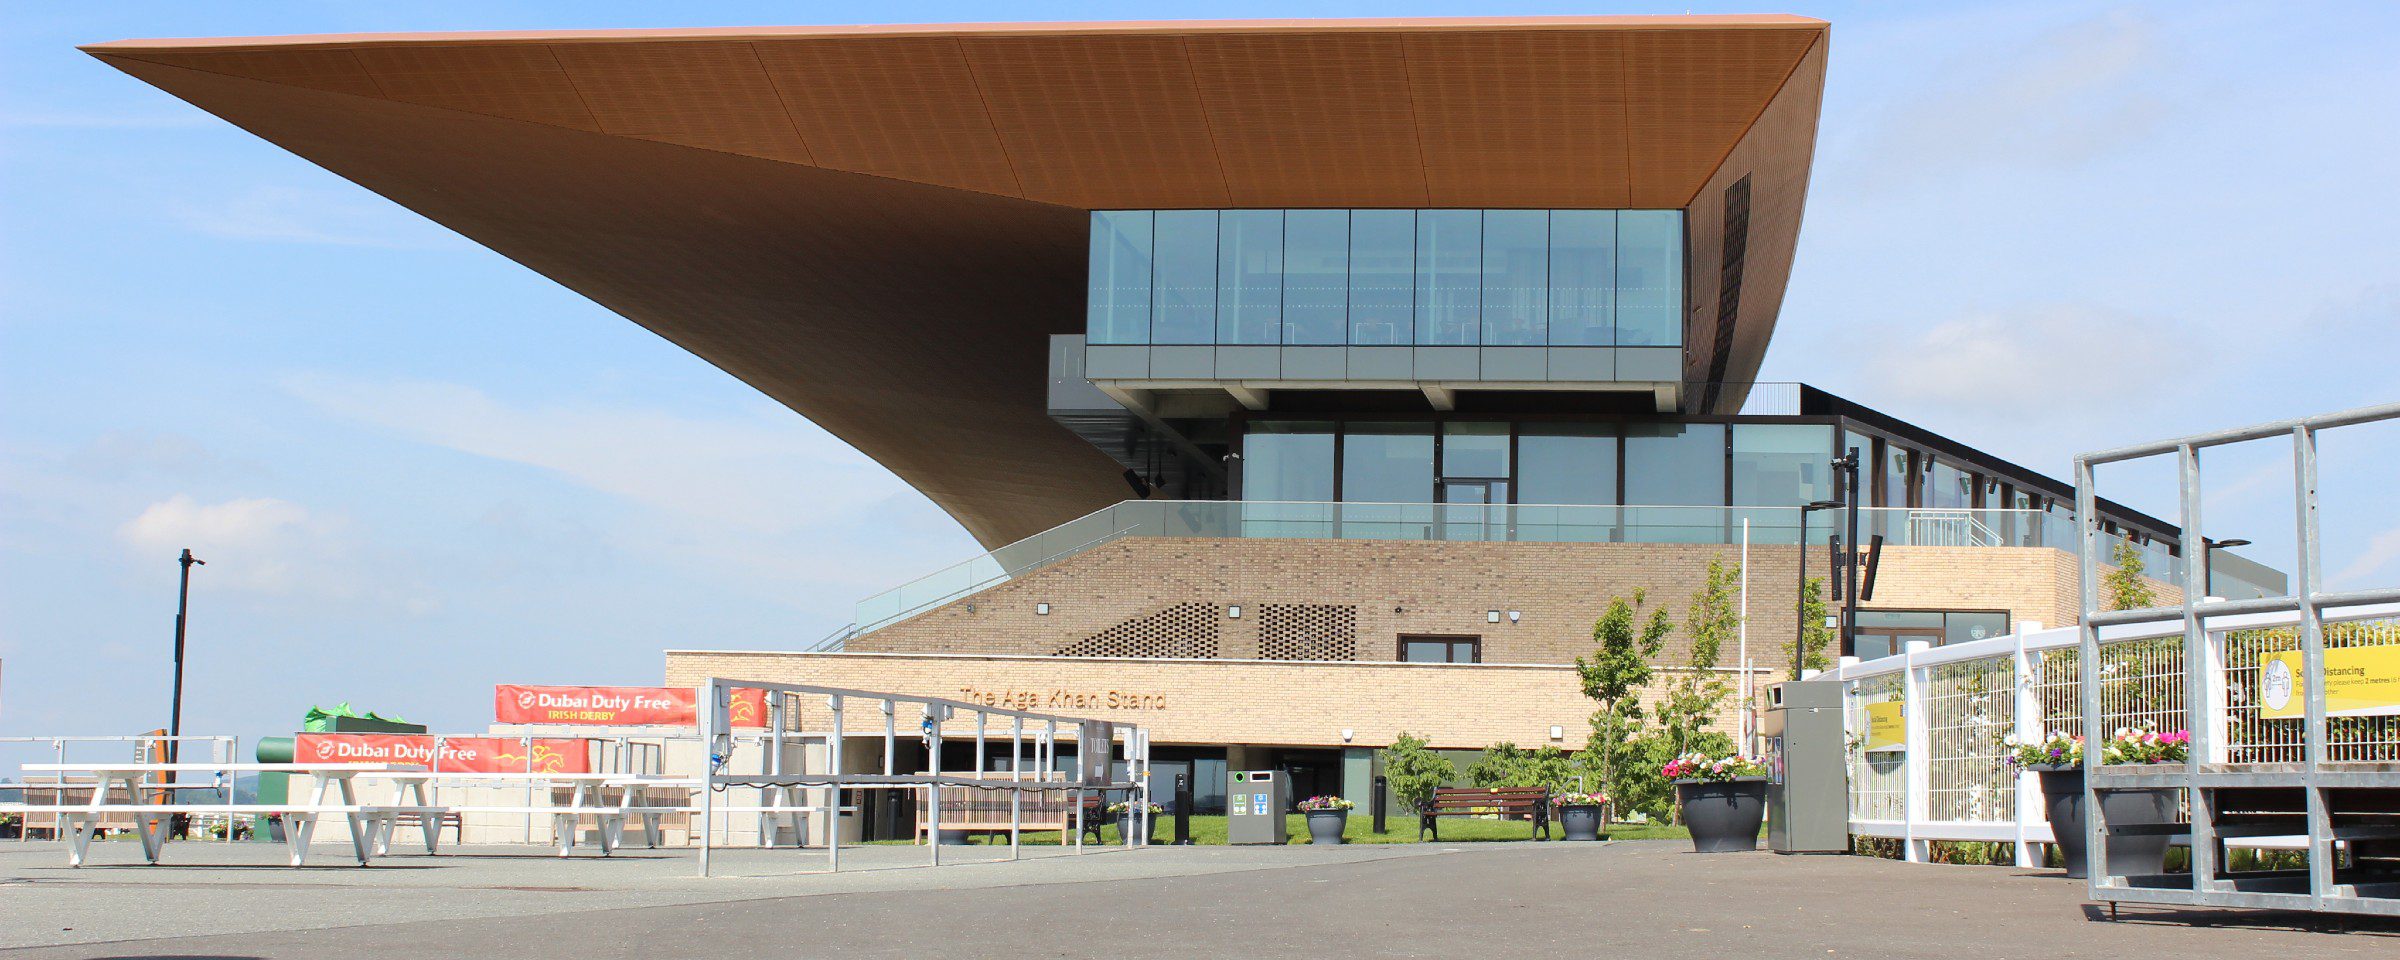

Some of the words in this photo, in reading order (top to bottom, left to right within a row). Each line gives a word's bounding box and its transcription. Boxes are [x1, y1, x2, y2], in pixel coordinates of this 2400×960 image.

[538, 693, 588, 709] Dubai
[592, 694, 632, 712] Duty
[634, 695, 672, 710] Free
[960, 685, 995, 706] The
[1003, 688, 1039, 711] Aga
[1049, 689, 1099, 709] Khan
[1107, 690, 1166, 710] Stand
[548, 710, 578, 720] IRISH
[579, 711, 616, 721] DERBY
[338, 742, 389, 758] Dubai
[394, 743, 435, 762] Duty
[438, 745, 477, 761] Free
